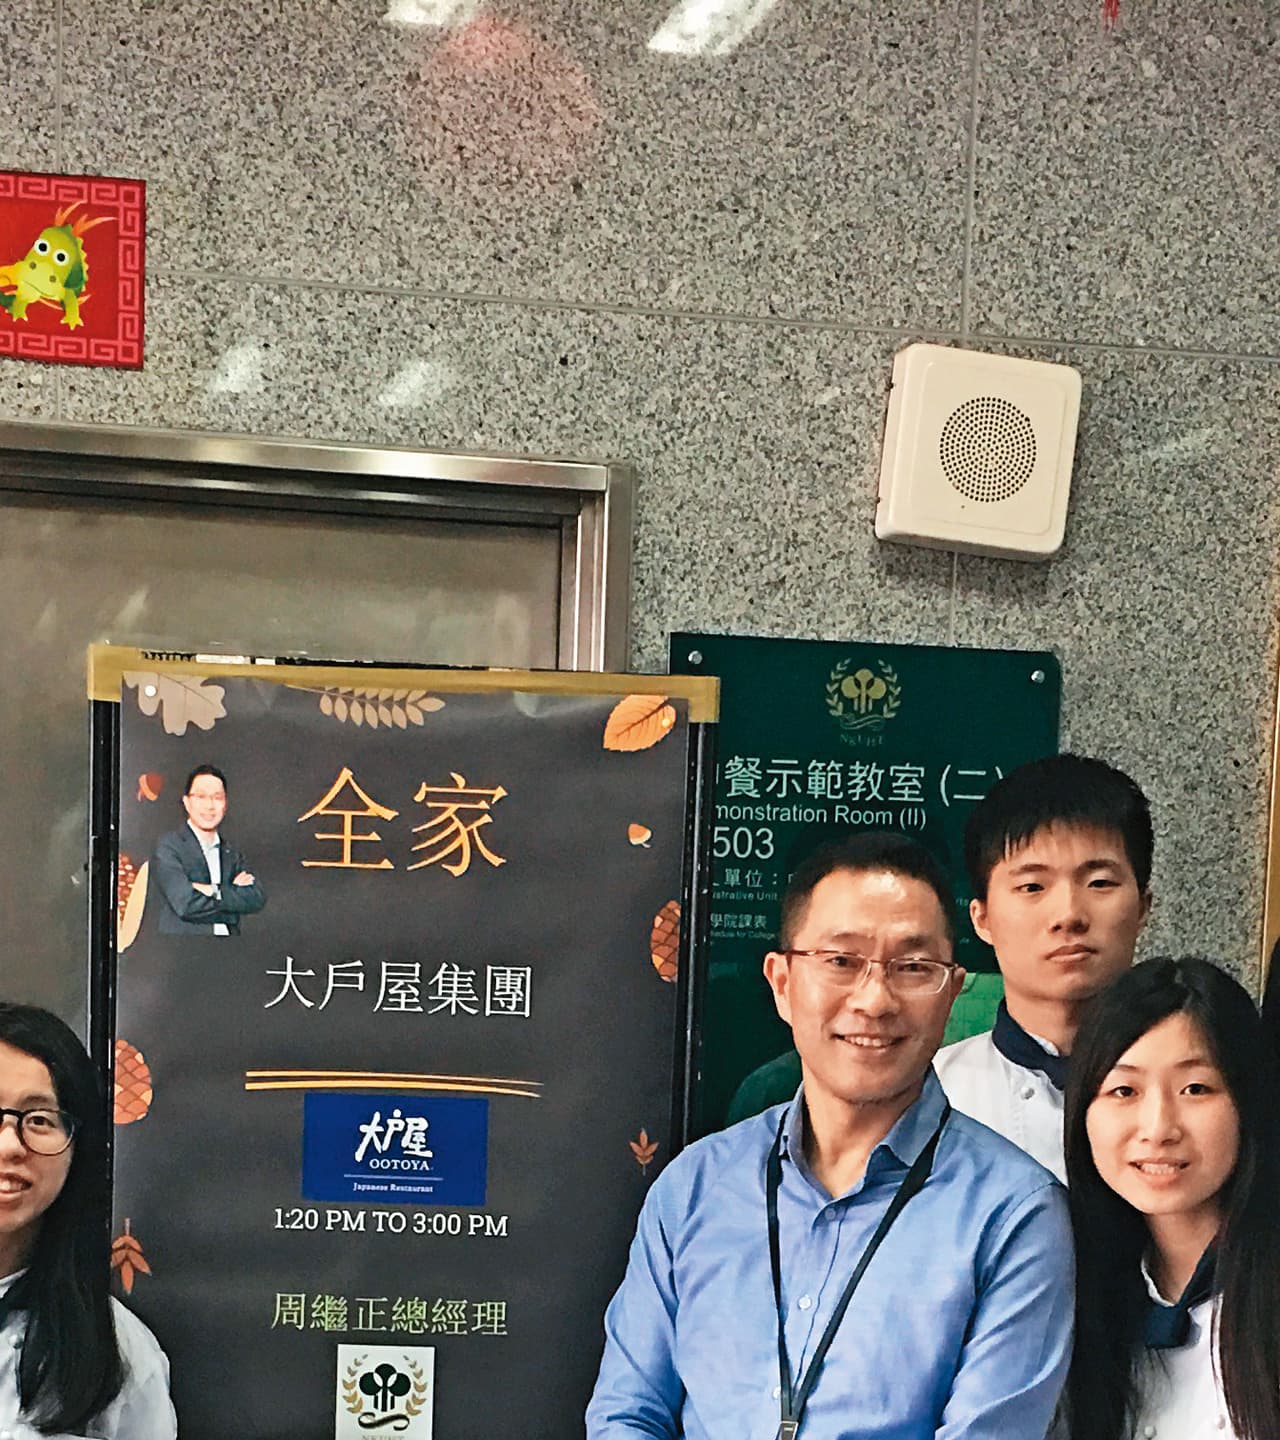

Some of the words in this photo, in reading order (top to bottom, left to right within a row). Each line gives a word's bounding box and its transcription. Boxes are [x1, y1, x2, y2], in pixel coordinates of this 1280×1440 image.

[297, 766, 509, 878] 全家
[835, 805, 893, 825] Room
[900, 807, 927, 831] (II)
[713, 826, 775, 859] 503
[264, 955, 533, 1019] 大戶屋集團
[369, 1158, 430, 1172] OOTOYA
[274, 1208, 319, 1230] 1:20
[325, 1210, 366, 1232] PM
[373, 1211, 407, 1233] TO
[413, 1212, 462, 1235] 3:00
[468, 1214, 508, 1237] PM
[271, 1292, 509, 1336] 周繼正總經理
